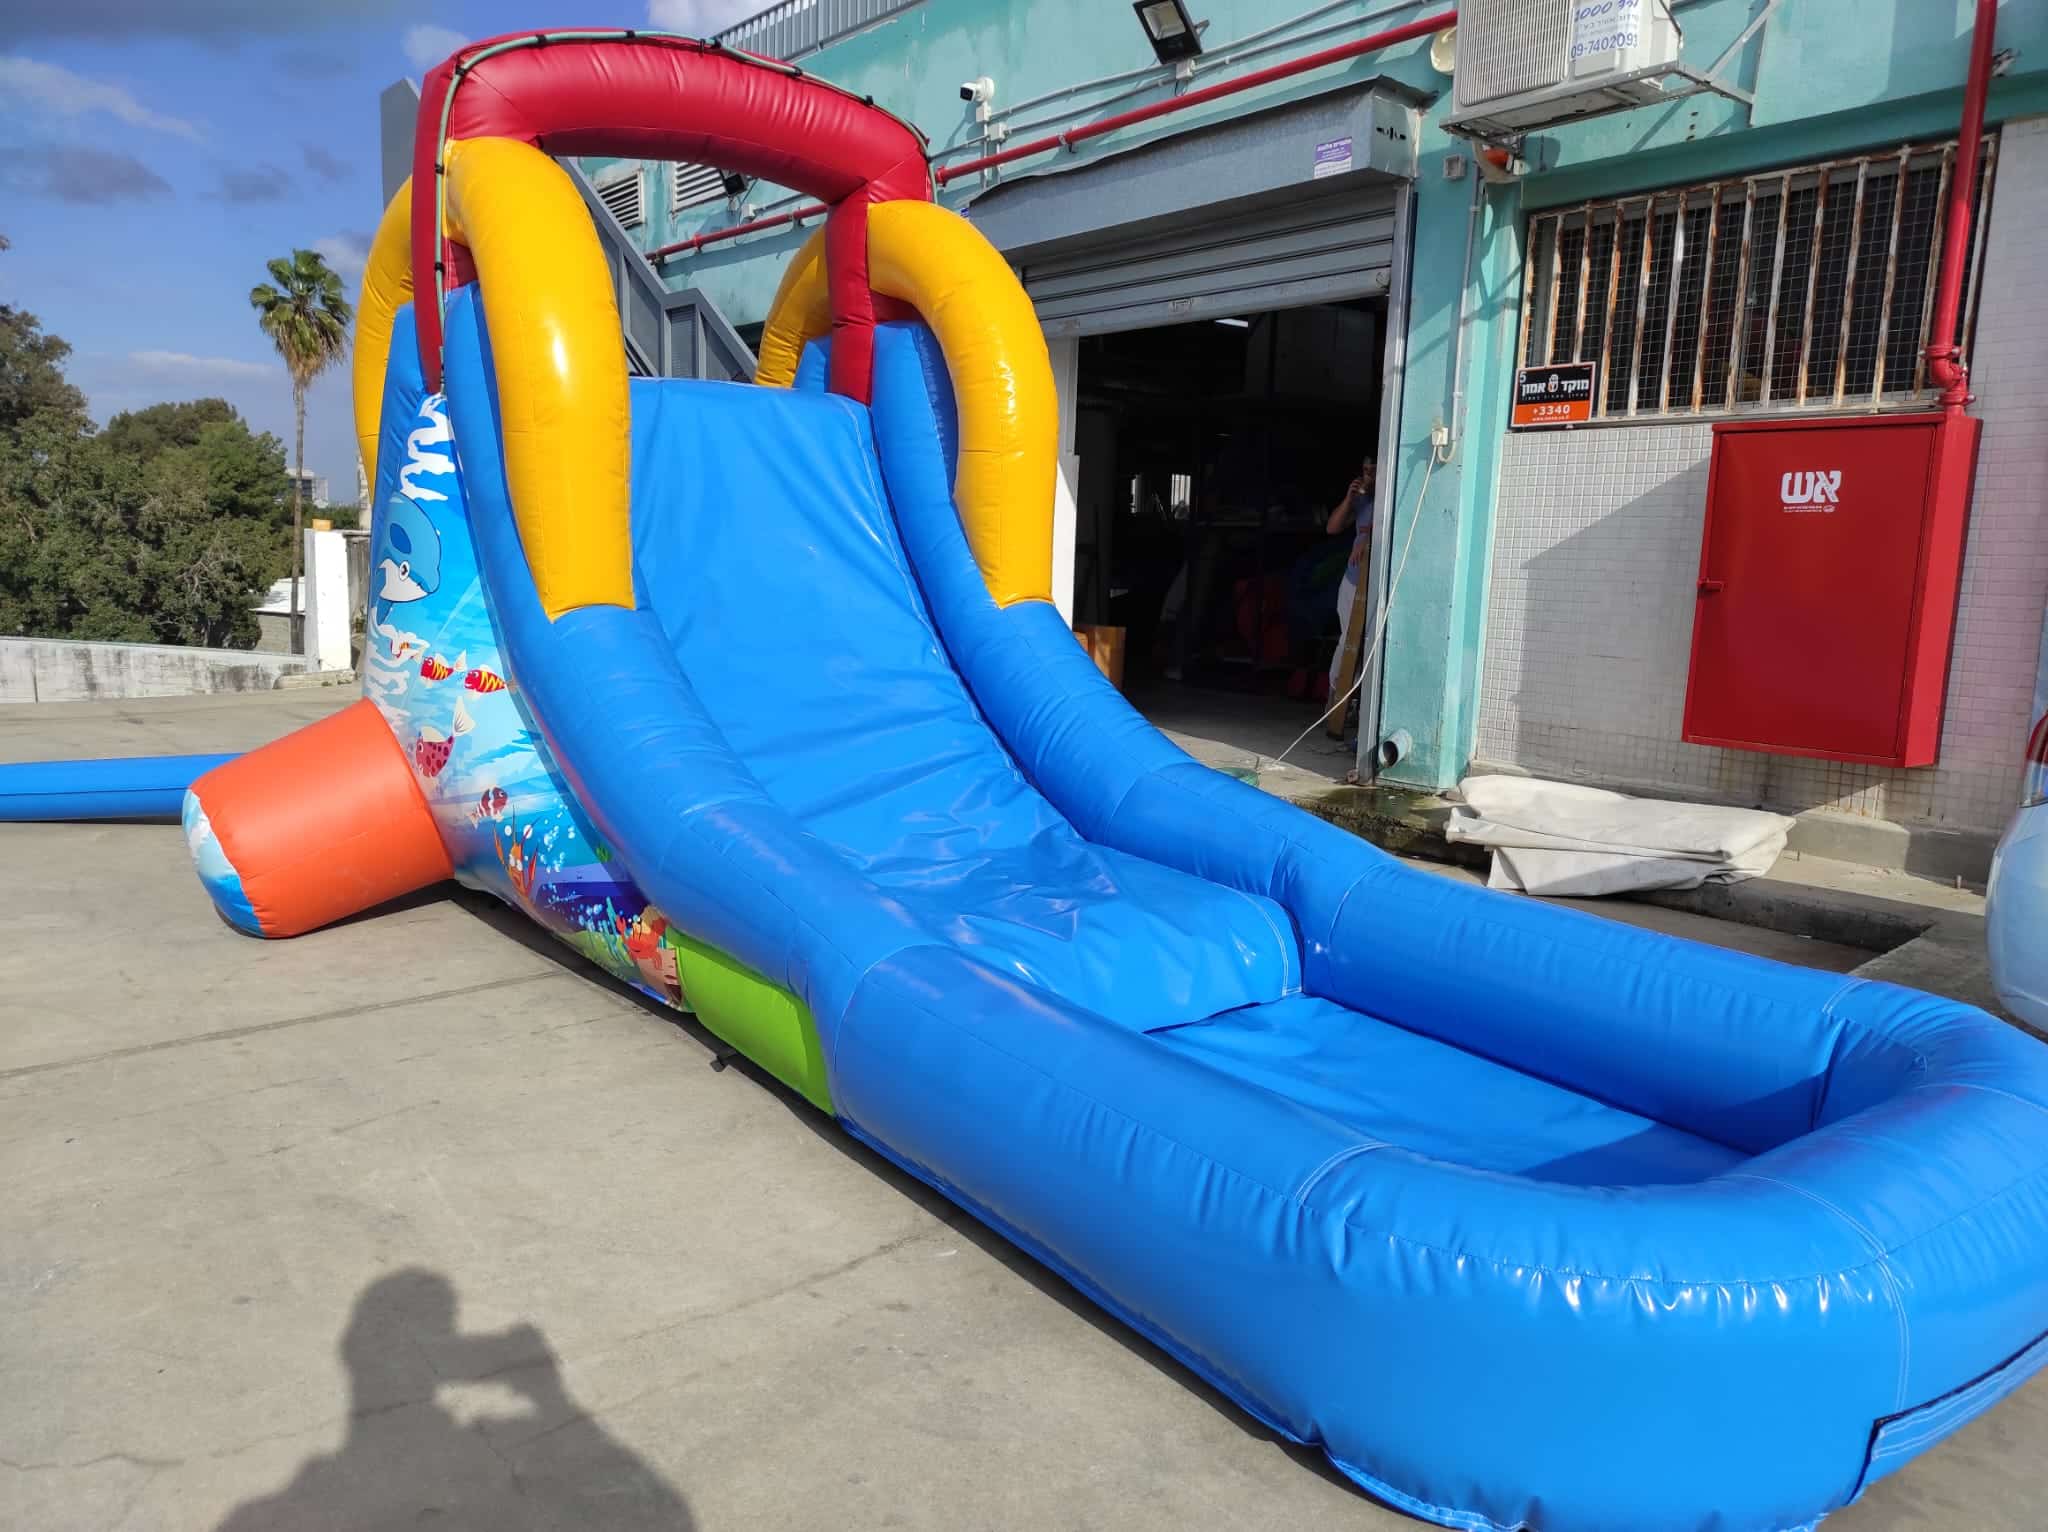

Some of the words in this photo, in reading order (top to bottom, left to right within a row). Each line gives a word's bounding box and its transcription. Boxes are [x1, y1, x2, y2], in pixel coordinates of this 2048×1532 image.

[1519, 371, 1527, 383] 5
[1521, 382, 1546, 397] אמון
[1560, 379, 1590, 393] מוקד
[1781, 470, 1842, 504] אש
